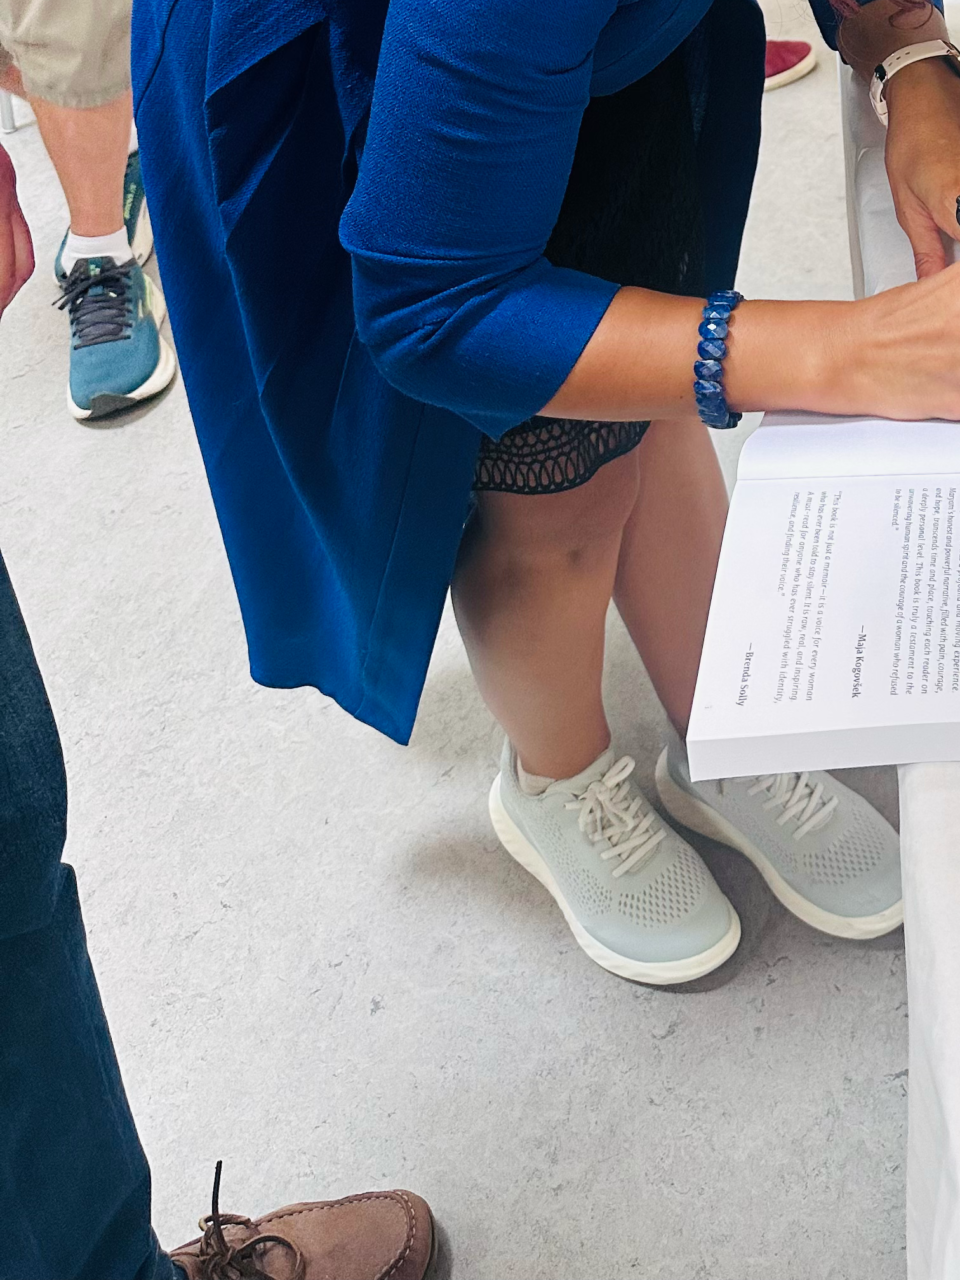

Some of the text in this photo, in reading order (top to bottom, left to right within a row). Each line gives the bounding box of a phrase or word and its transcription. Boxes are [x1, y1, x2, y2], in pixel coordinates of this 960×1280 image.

[851, 656, 864, 698] Kogovšek
[952, 650, 960, 693] experience.
[736, 684, 749, 707] Solly
